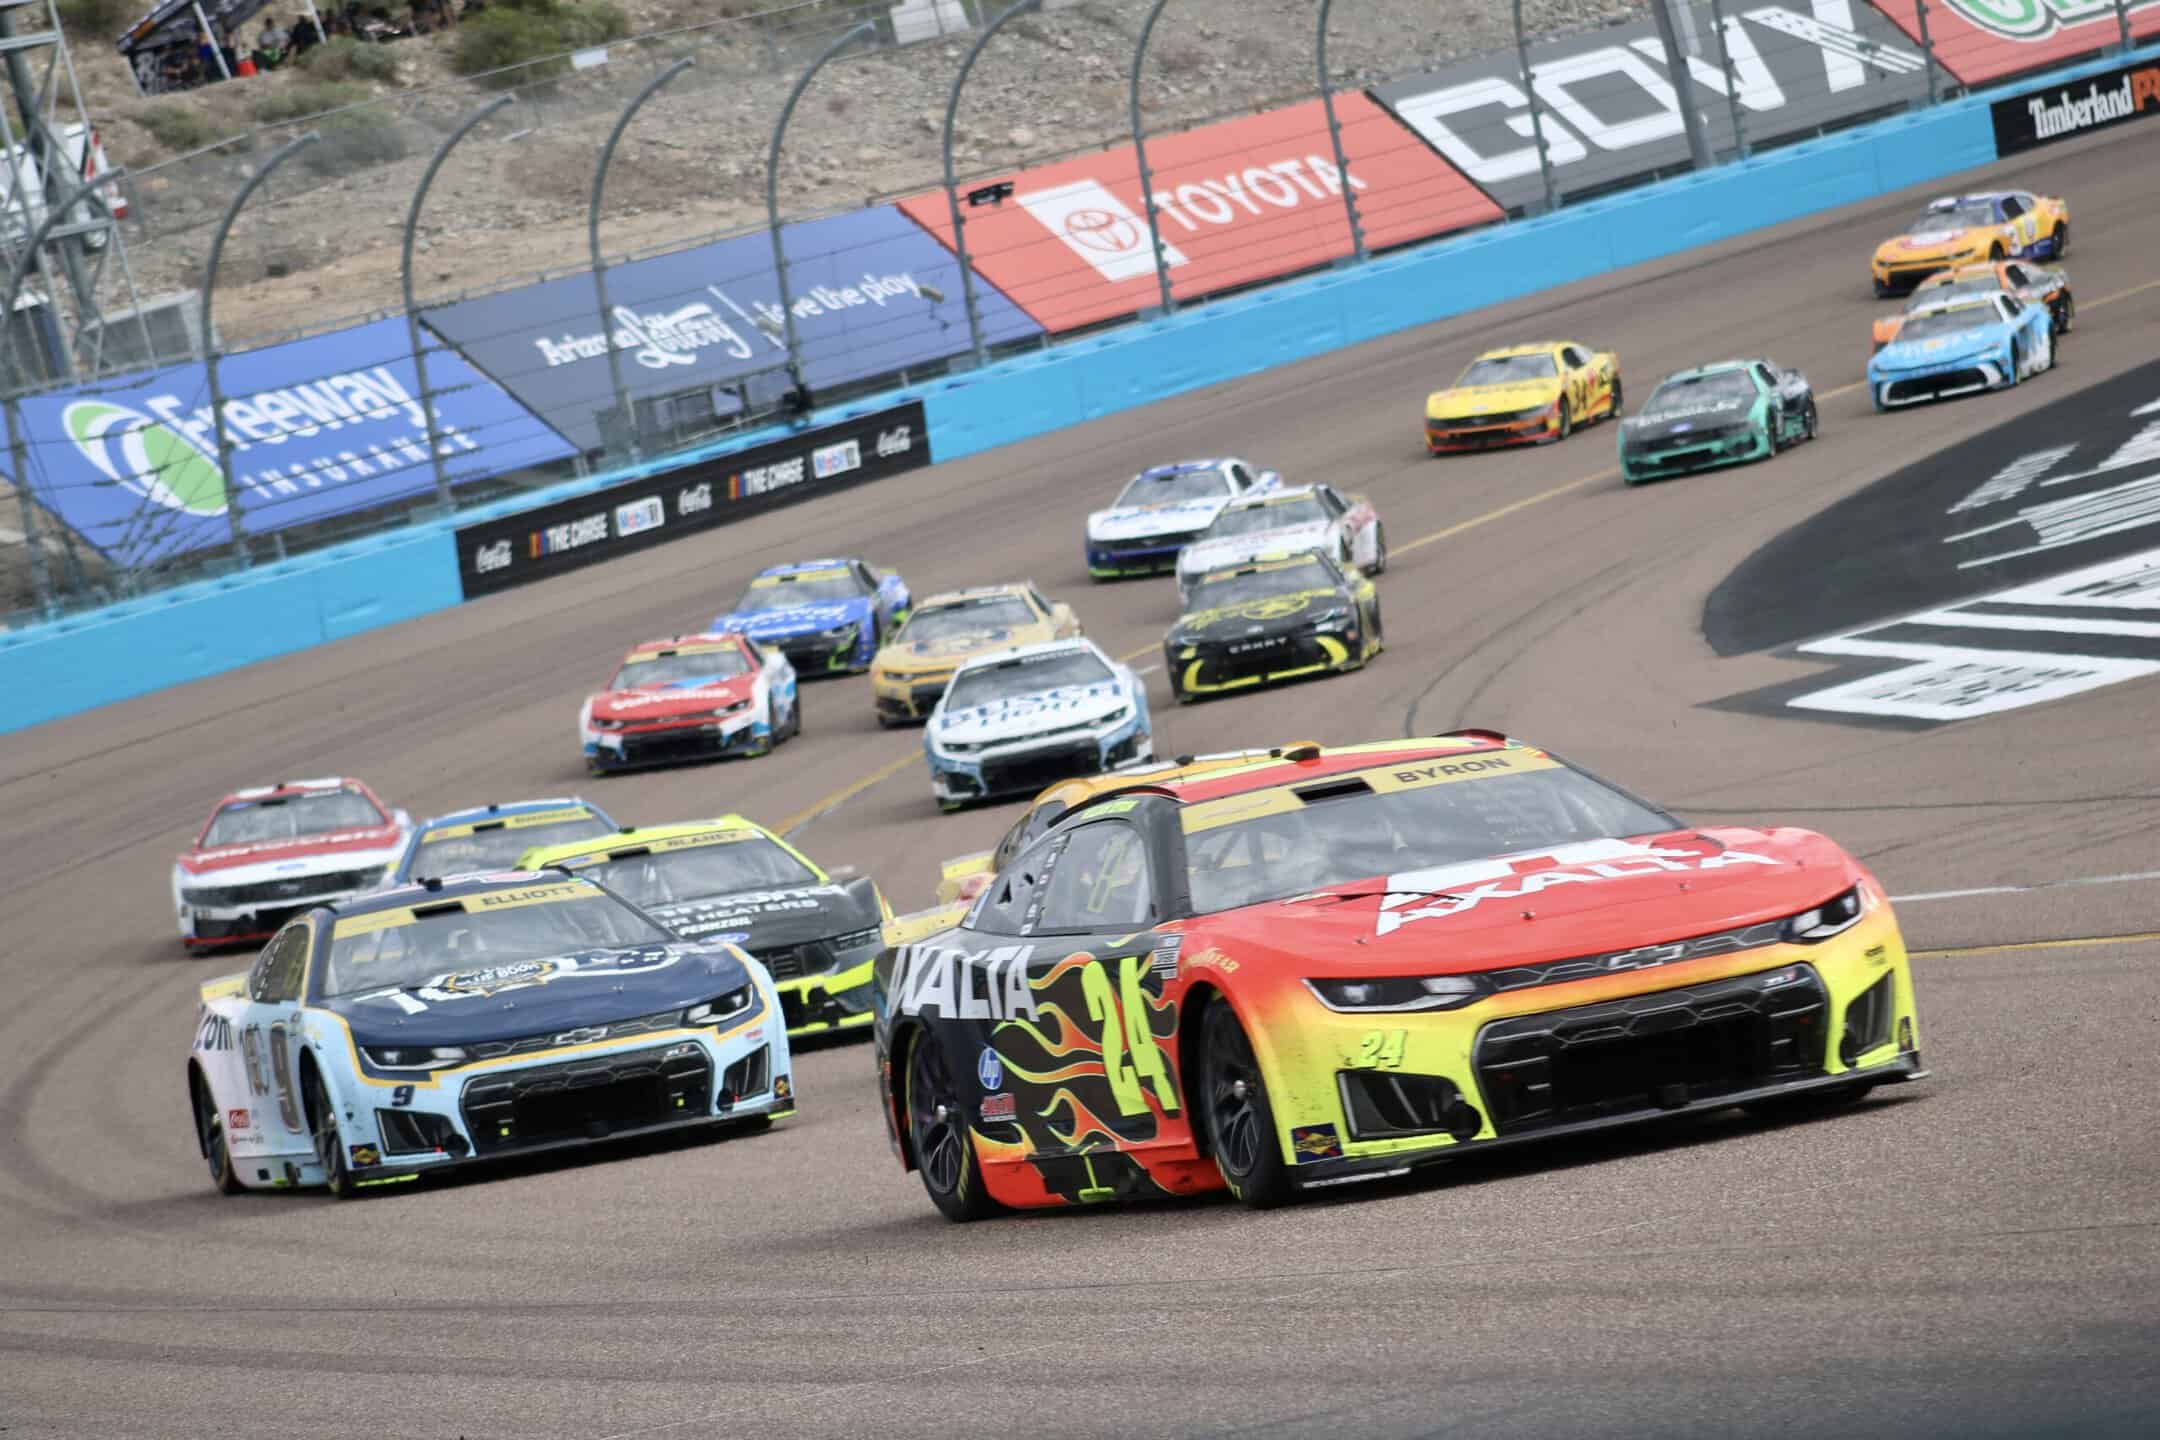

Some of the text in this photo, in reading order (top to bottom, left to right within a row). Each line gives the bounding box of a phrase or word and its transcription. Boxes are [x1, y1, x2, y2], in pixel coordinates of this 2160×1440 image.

[2028, 73, 2136, 140] Timberland
[1140, 154, 1367, 232] TOYOTA
[145, 366, 442, 459] Freeway
[1391, 757, 1514, 784] BYRON
[481, 886, 576, 905] ELLIOTT
[1376, 851, 1784, 937] AXALTA
[1081, 955, 1182, 1118] 24
[1355, 1029, 1408, 1069] 24
[391, 1084, 416, 1107] 9
